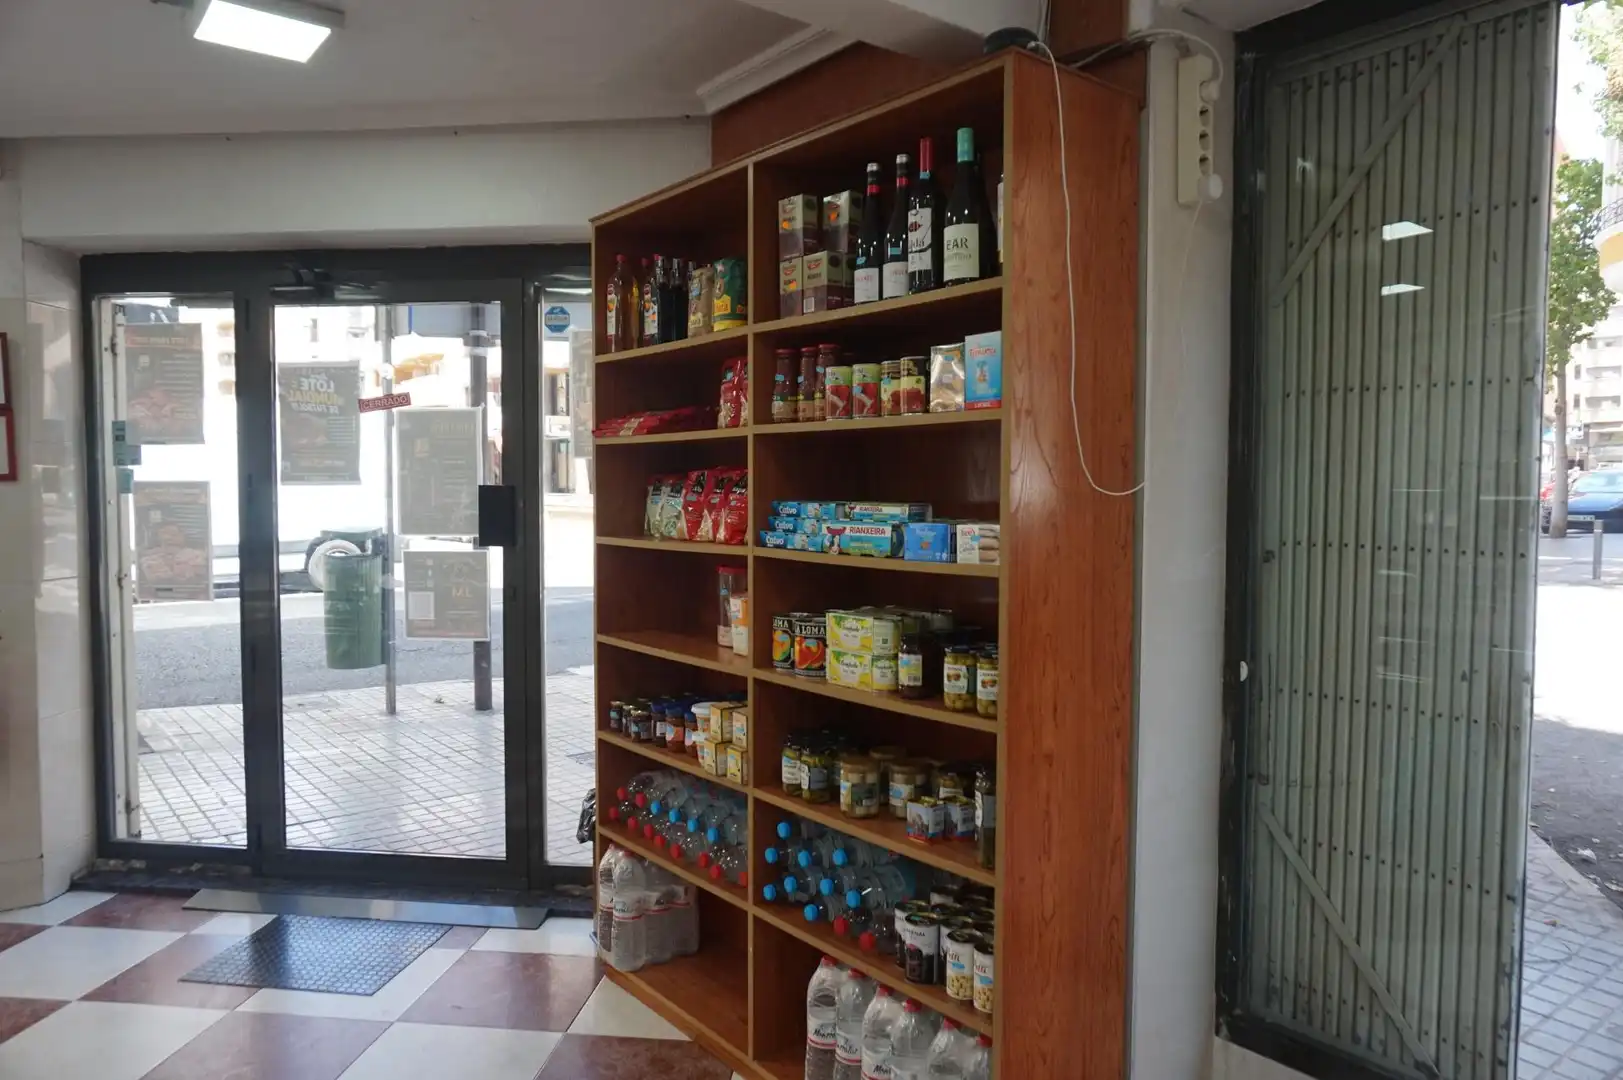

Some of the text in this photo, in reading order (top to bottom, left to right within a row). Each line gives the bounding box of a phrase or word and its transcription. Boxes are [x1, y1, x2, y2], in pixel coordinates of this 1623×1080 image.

[363, 395, 409, 410] CERRADO
[778, 506, 797, 514] Calvo
[775, 520, 794, 530] Calvo
[849, 526, 886, 536] RIANXEIRA
[766, 536, 784, 545] Calvo
